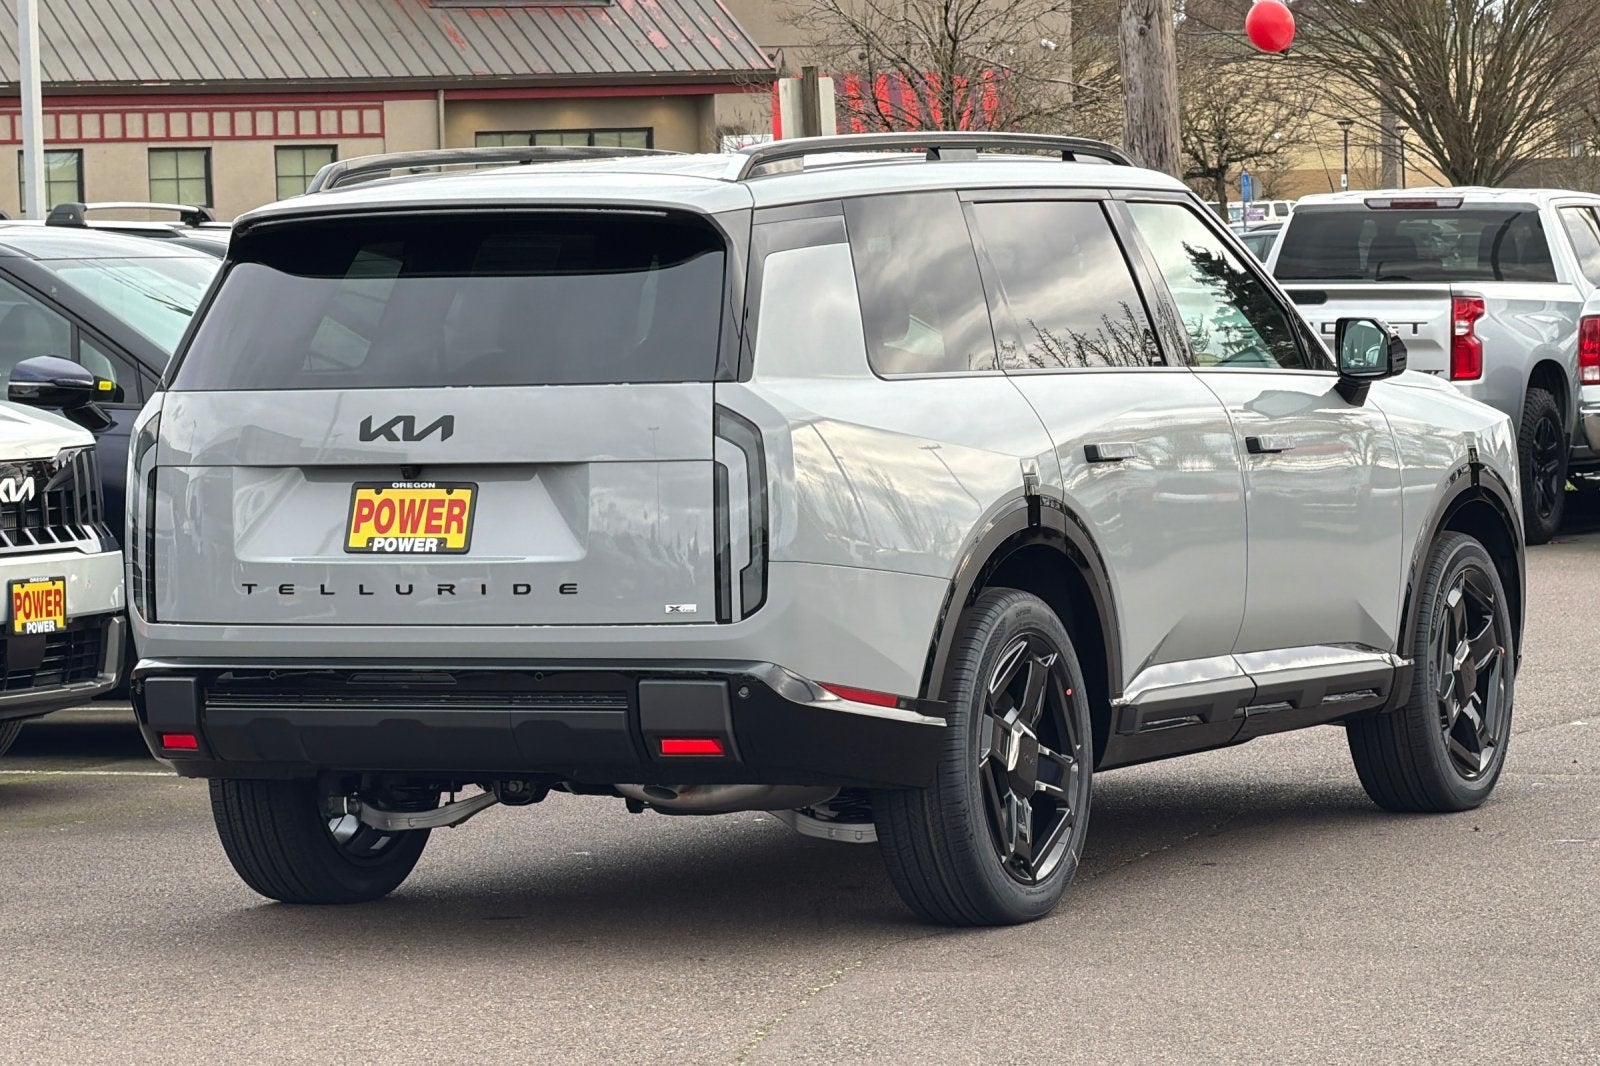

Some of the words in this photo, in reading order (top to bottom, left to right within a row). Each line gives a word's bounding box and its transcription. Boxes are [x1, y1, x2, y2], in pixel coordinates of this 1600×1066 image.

[359, 414, 454, 441] KIA
[353, 498, 467, 535] POWER
[372, 537, 438, 552] POWER
[242, 583, 578, 596] TELLURIDE
[14, 589, 63, 621] POWER
[26, 620, 55, 634] POWER
